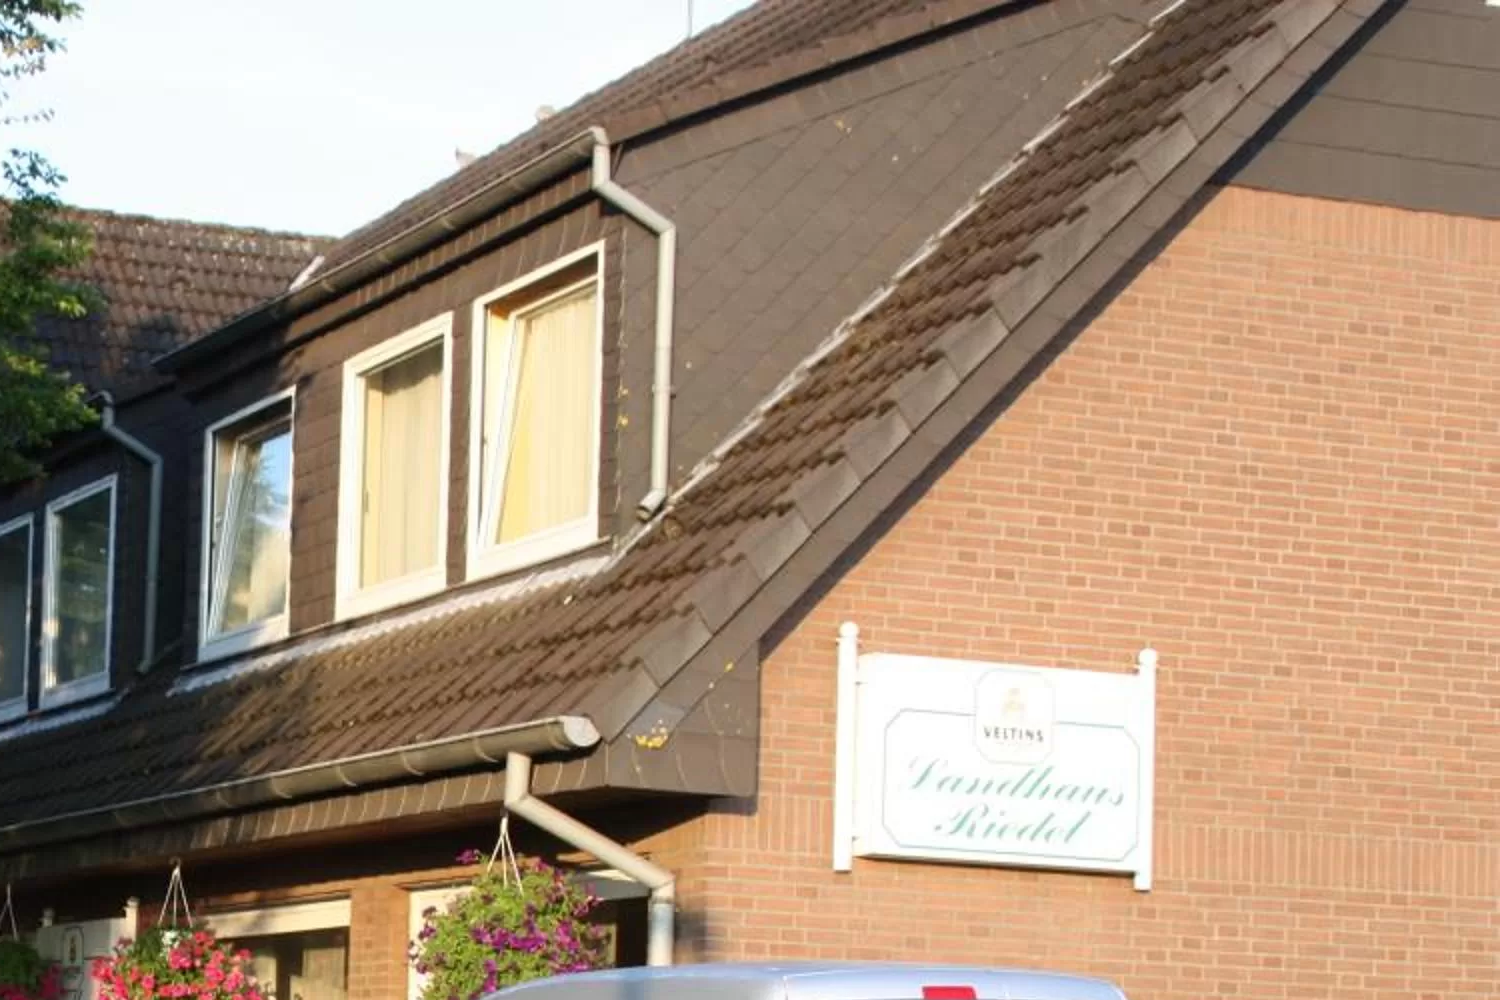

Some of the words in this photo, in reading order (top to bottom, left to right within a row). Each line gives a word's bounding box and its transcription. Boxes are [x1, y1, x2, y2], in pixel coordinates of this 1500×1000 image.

[983, 725, 1045, 743] VELTINS
[907, 755, 1125, 808] Landhaus
[933, 801, 1093, 845] Riedel
